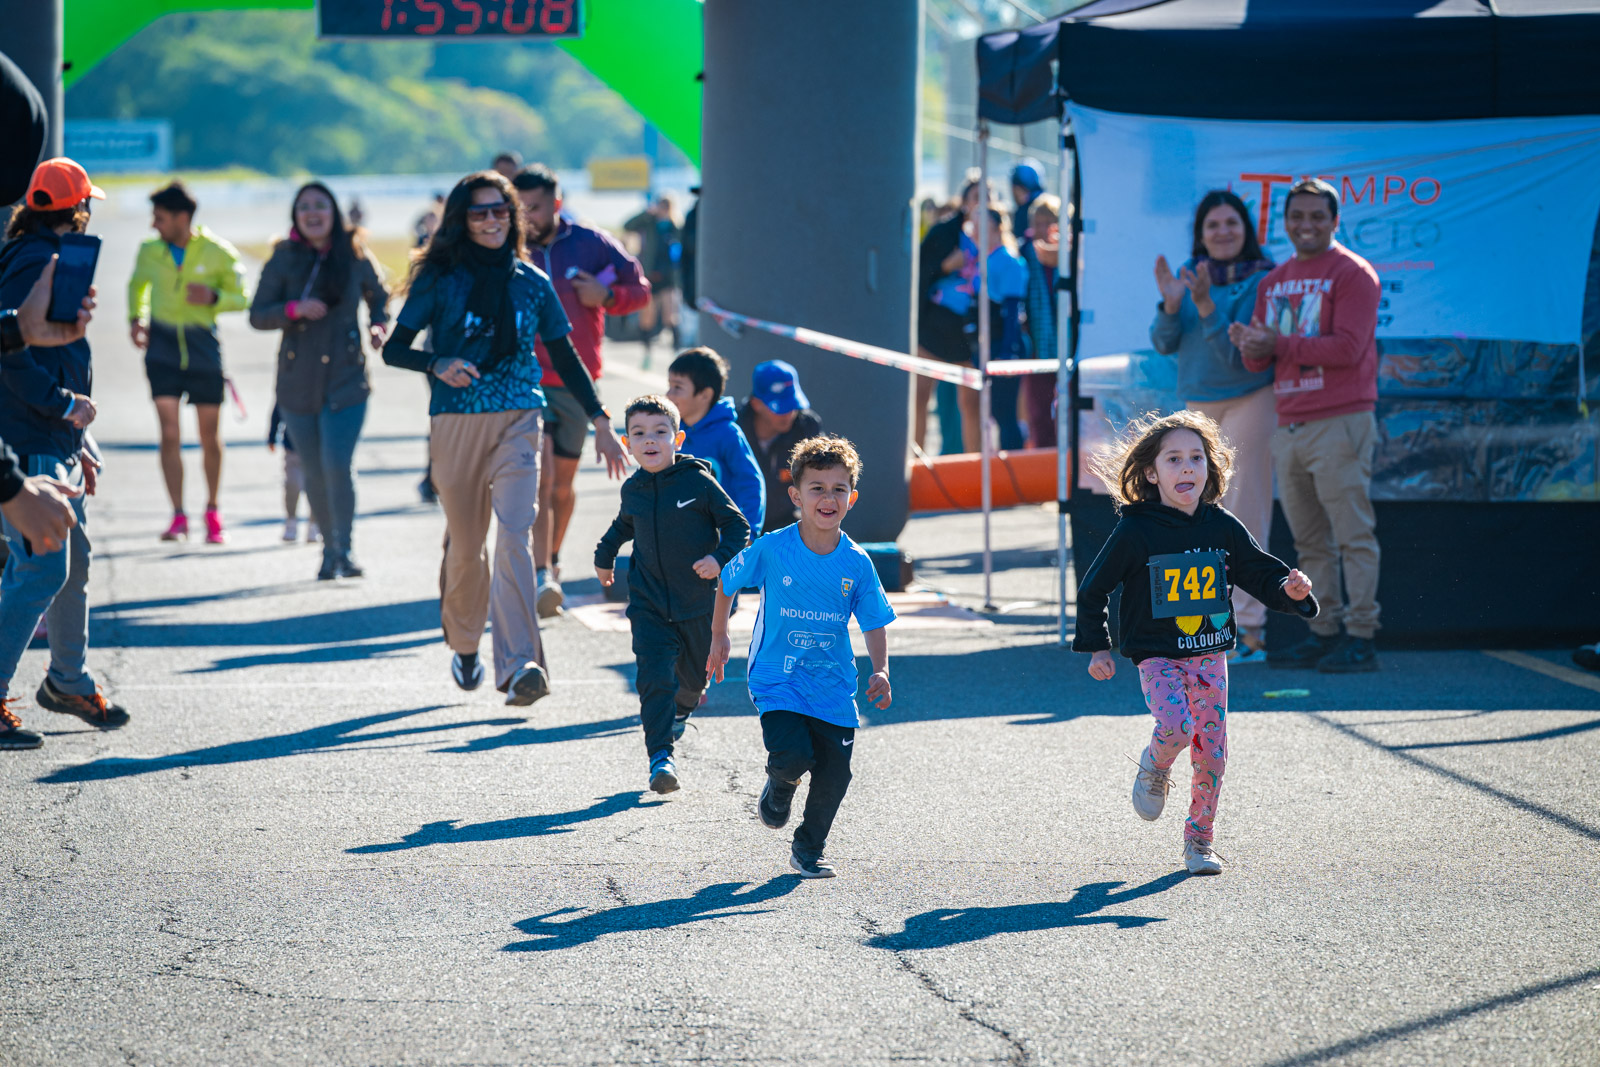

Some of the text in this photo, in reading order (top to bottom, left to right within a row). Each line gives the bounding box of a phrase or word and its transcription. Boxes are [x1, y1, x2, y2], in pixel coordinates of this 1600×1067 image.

[380, 0, 573, 34] 1:55:08
[1240, 173, 1442, 245] TMPO
[1267, 187, 1441, 249] ECTO
[1164, 565, 1216, 601] 742
[1177, 626, 1233, 649] COLOURFUL
